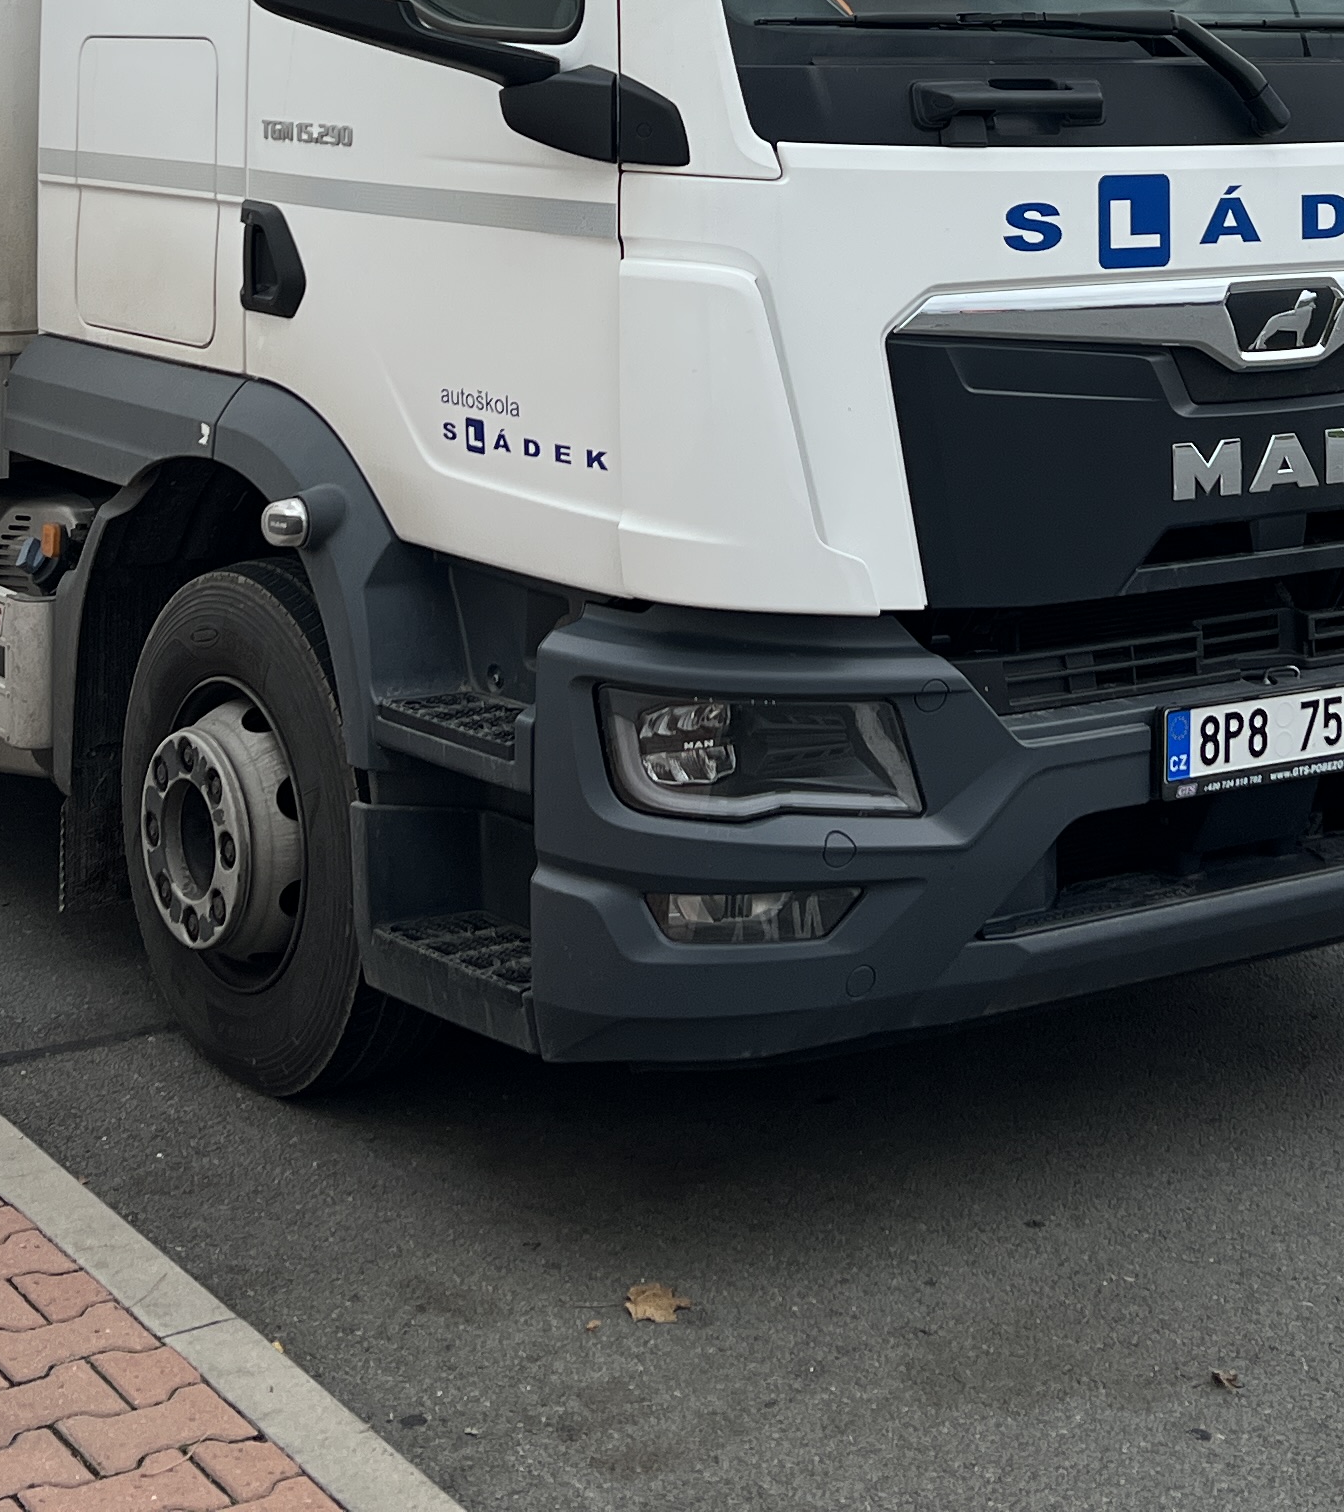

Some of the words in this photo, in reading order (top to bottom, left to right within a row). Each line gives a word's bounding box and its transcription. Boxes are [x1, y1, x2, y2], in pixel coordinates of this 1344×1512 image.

[261, 119, 294, 142] TGM
[440, 387, 520, 418] autoškola
[442, 421, 609, 472] SLÁDEK
[683, 738, 714, 751] MAN
[1199, 707, 1269, 767] 8P8
[1169, 753, 1188, 773] CZ
